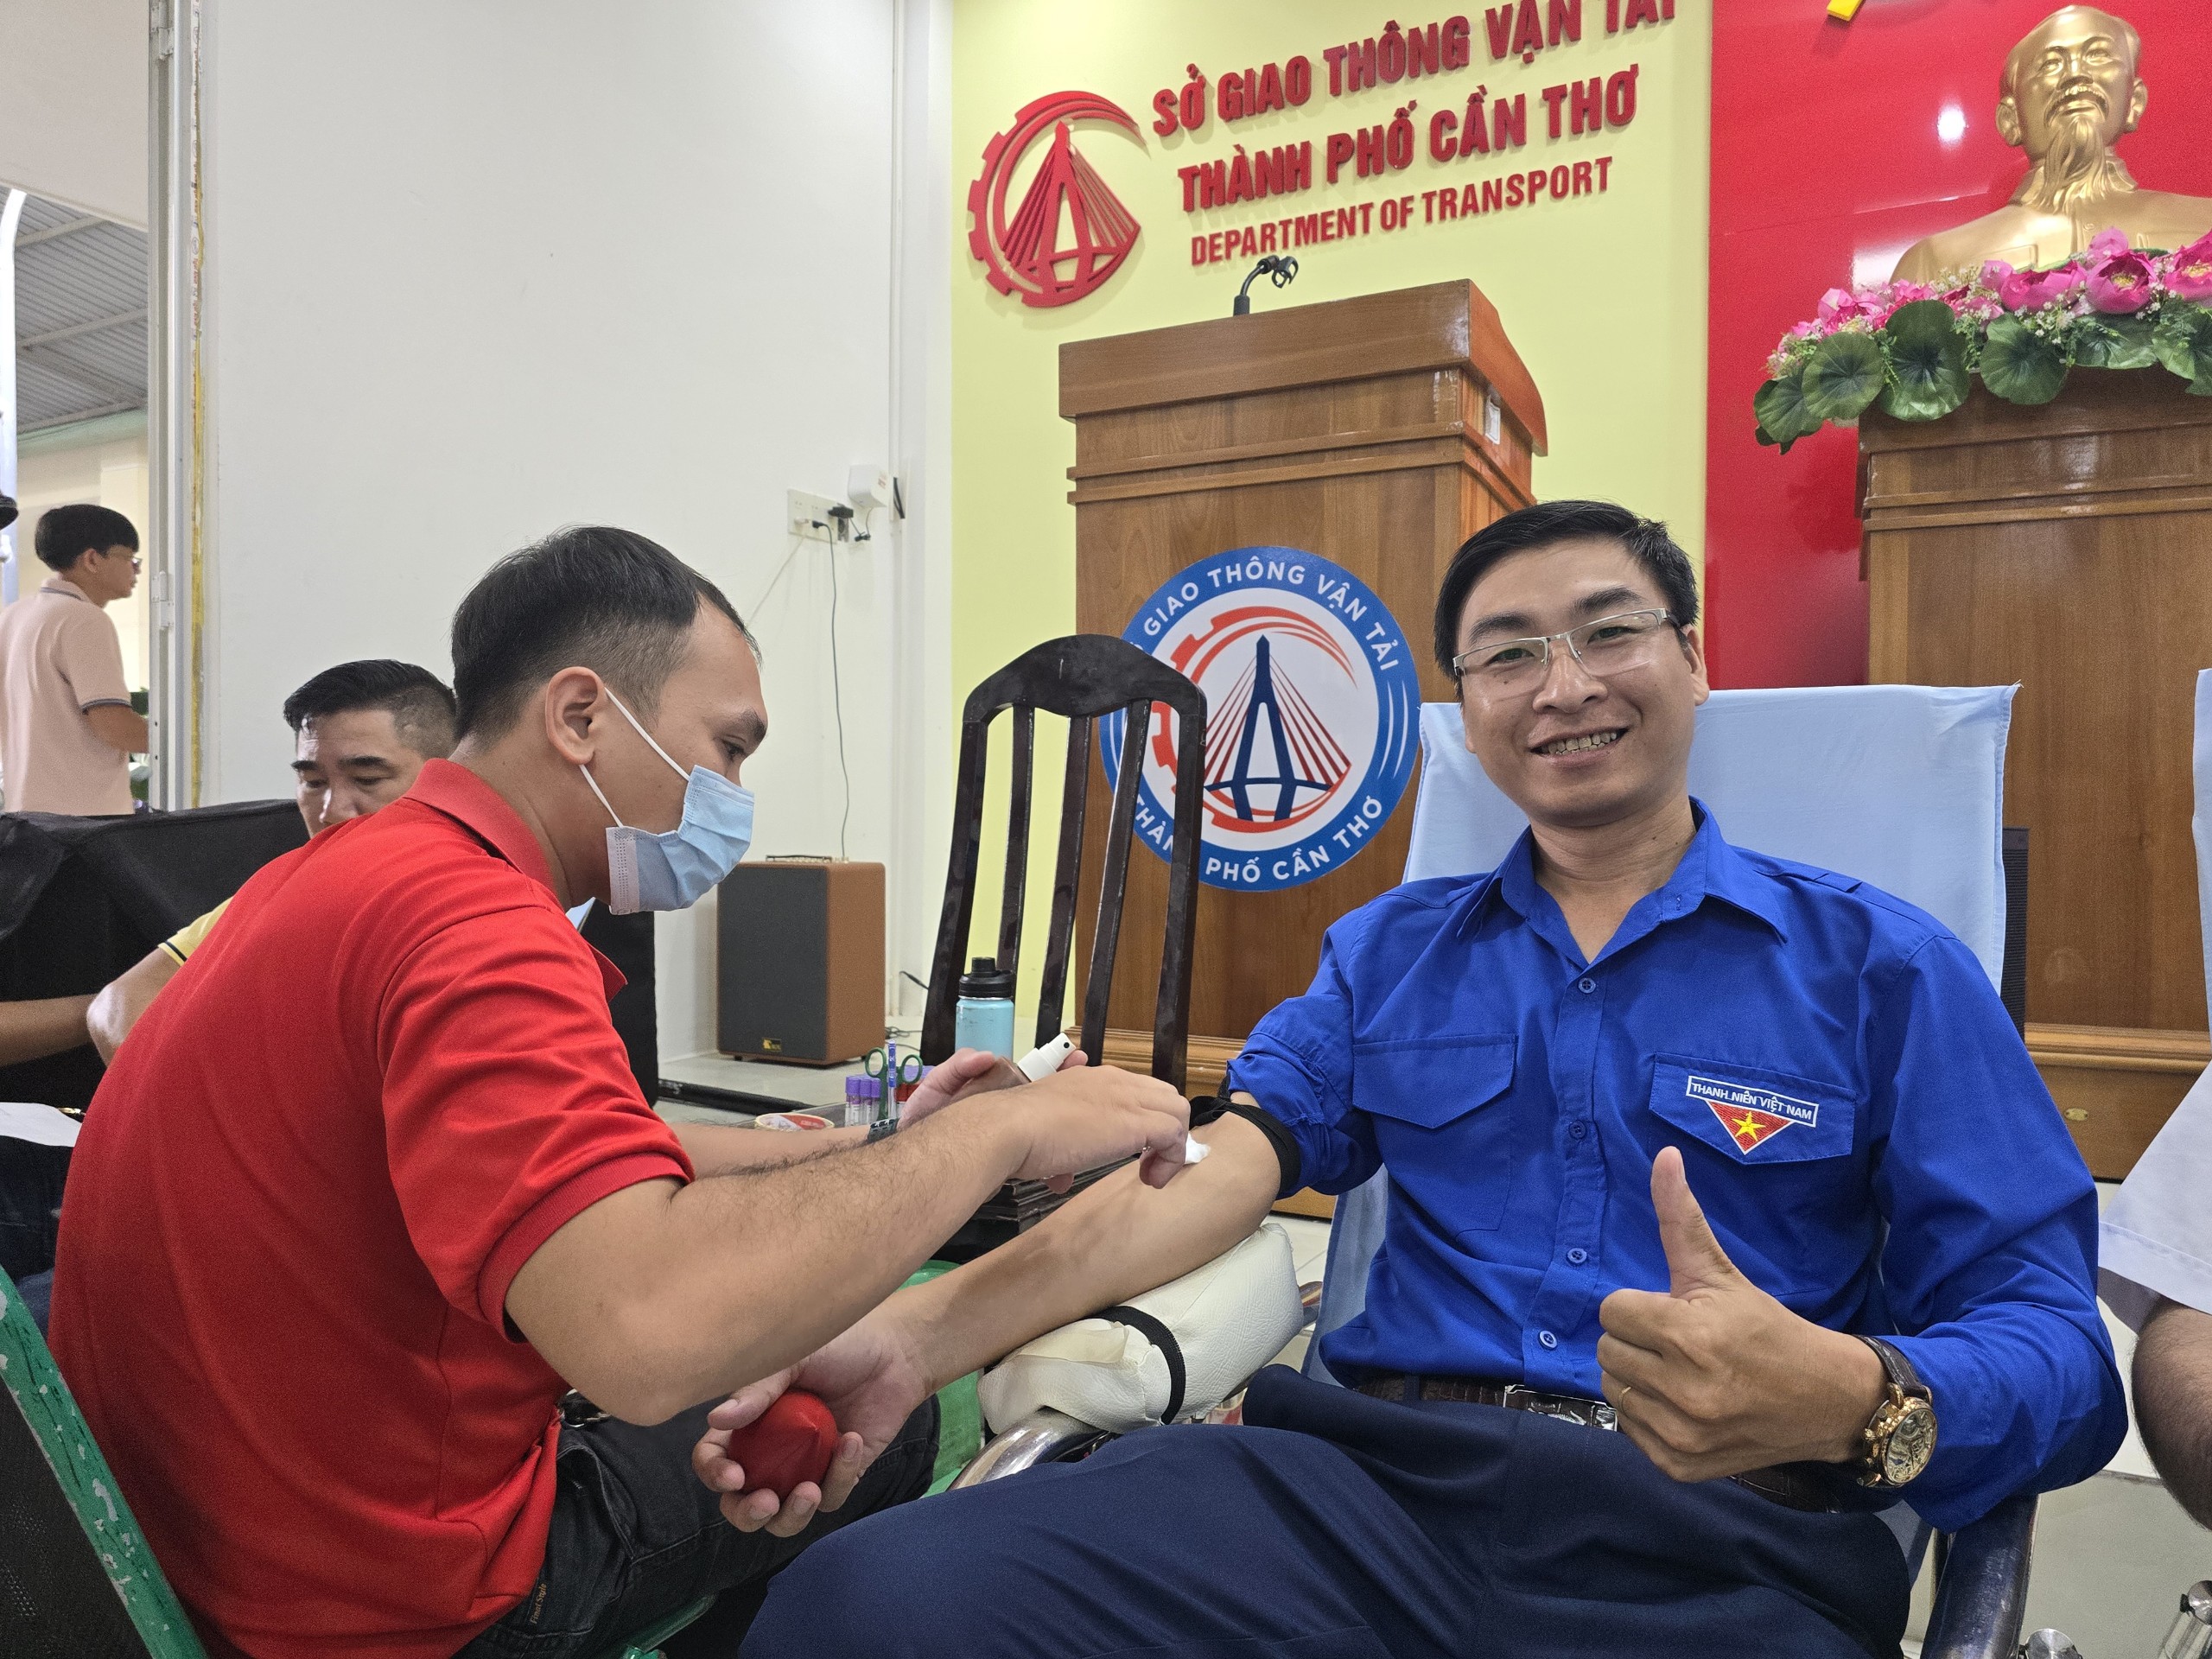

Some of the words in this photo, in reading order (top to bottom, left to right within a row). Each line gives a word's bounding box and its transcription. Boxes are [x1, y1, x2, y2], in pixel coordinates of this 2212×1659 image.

[1153, 63, 1206, 137] SỞ
[1217, 55, 1312, 123] GIAO
[1323, 16, 1470, 97] THÔNG
[1178, 143, 1312, 213] THÀNH
[1326, 99, 1418, 184] PHỐ
[1429, 84, 1527, 162] CẦN
[1541, 63, 1639, 138] THƠ
[1191, 202, 1375, 266] DEPARTMENT
[1380, 195, 1414, 232] OF
[1421, 156, 1612, 224] TRANSPORT
[1143, 582, 1199, 636] GIAO
[1207, 556, 1306, 588] THÔNG
[1317, 575, 1368, 622] VẬN
[1365, 622, 1399, 671] TẢI
[1205, 856, 1261, 883] PHỐ
[1273, 845, 1331, 880] CẦN
[1332, 795, 1382, 849] THƠ
[1692, 1083, 1728, 1099] THANH
[1731, 1090, 1757, 1105] NIÊN
[1760, 1096, 1784, 1112] VIỆT
[1786, 1105, 1812, 1120] NAM
